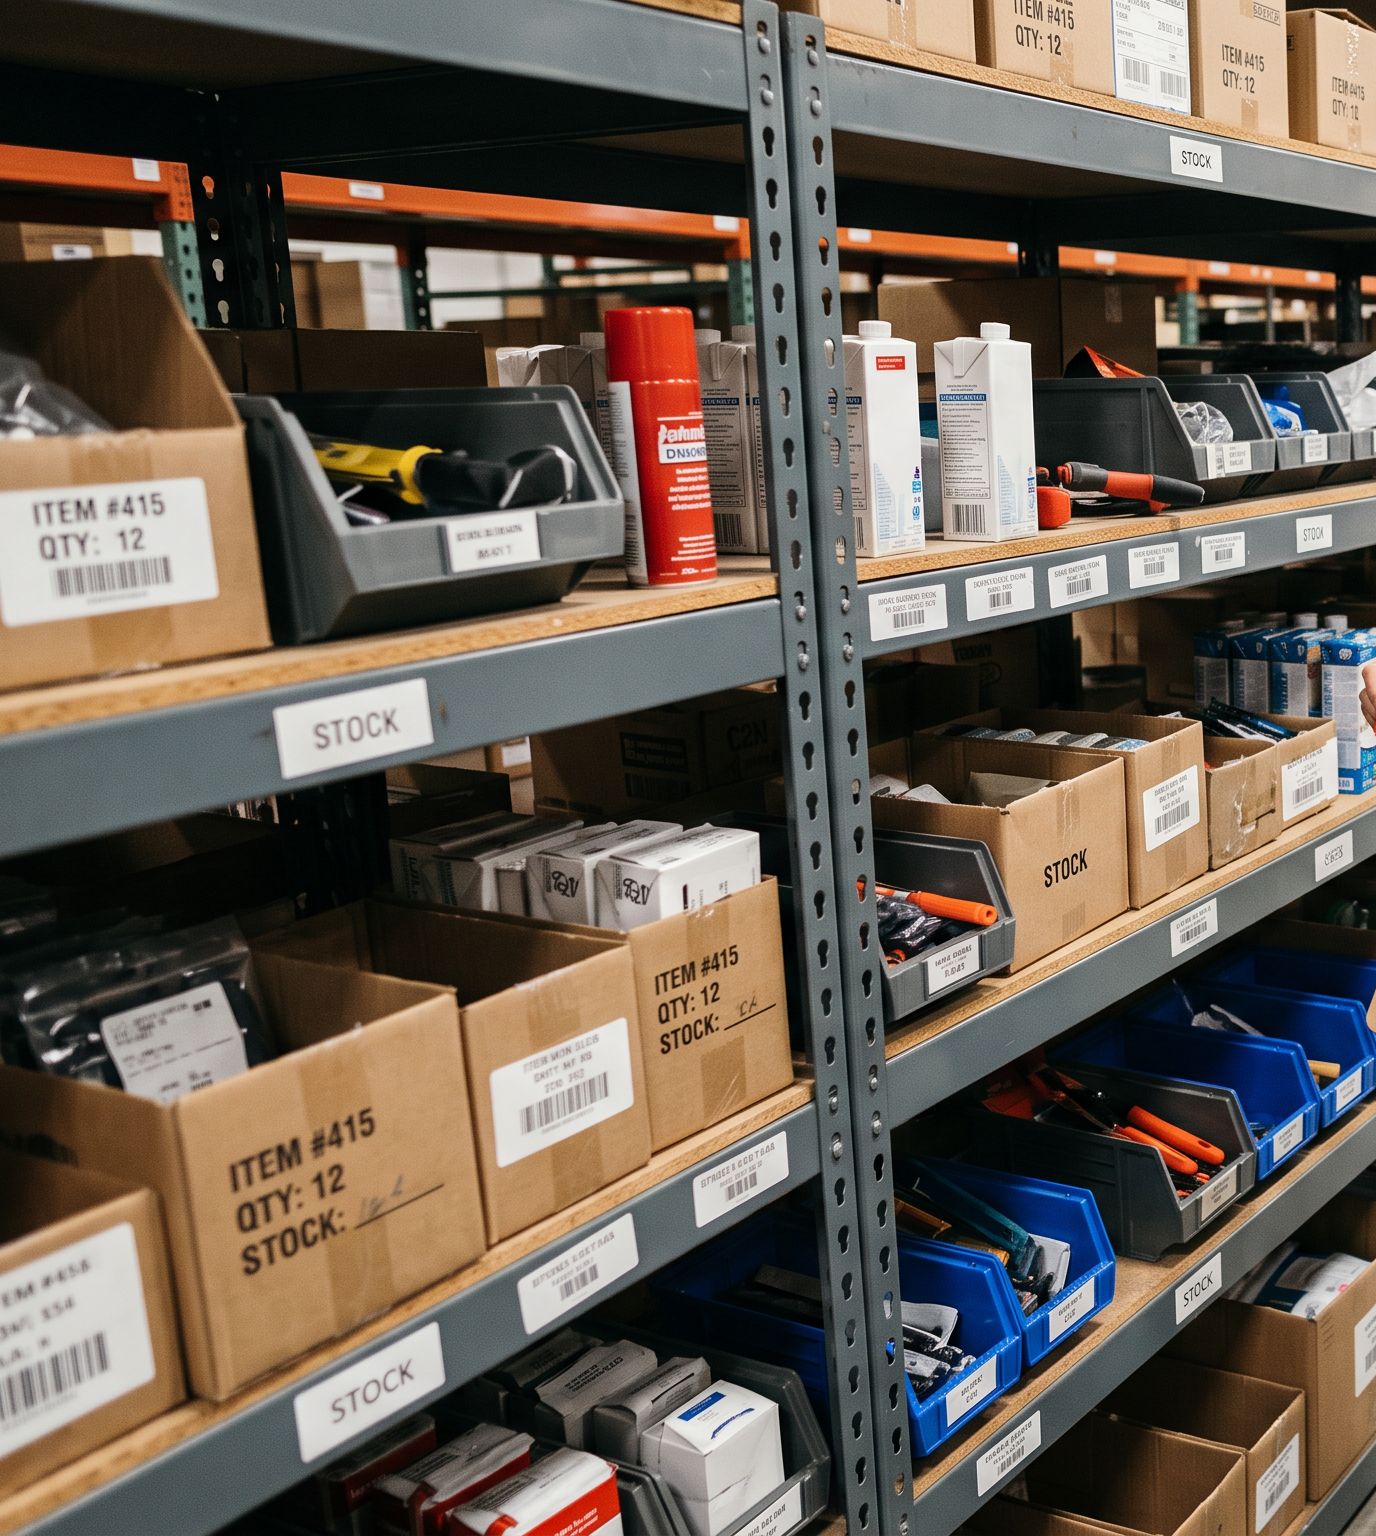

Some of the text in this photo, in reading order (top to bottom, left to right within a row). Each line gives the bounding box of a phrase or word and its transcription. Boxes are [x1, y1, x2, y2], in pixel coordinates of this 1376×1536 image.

[1047, 5, 1075, 31] #415
[1015, 24, 1062, 56] QTY: 12
[1221, 44, 1242, 67] ITEM
[1222, 69, 1255, 94] QTY: 12
[1181, 150, 1212, 170] STOCK
[33, 492, 165, 527] ITEM #415
[39, 528, 145, 561] QTY: 12
[313, 708, 400, 751] STOCK
[1044, 848, 1089, 888] STOCK
[654, 944, 740, 996] ITEM #415
[657, 981, 721, 1025] QTY: 12
[659, 1012, 720, 1055] STOCK:
[229, 1107, 376, 1193] ITEM #415
[236, 1183, 304, 1233] QTY:
[311, 1163, 346, 1200] 12
[241, 1207, 347, 1277] STOCK:
[1183, 1271, 1215, 1308] STOCK
[331, 1357, 415, 1425] STOCK
